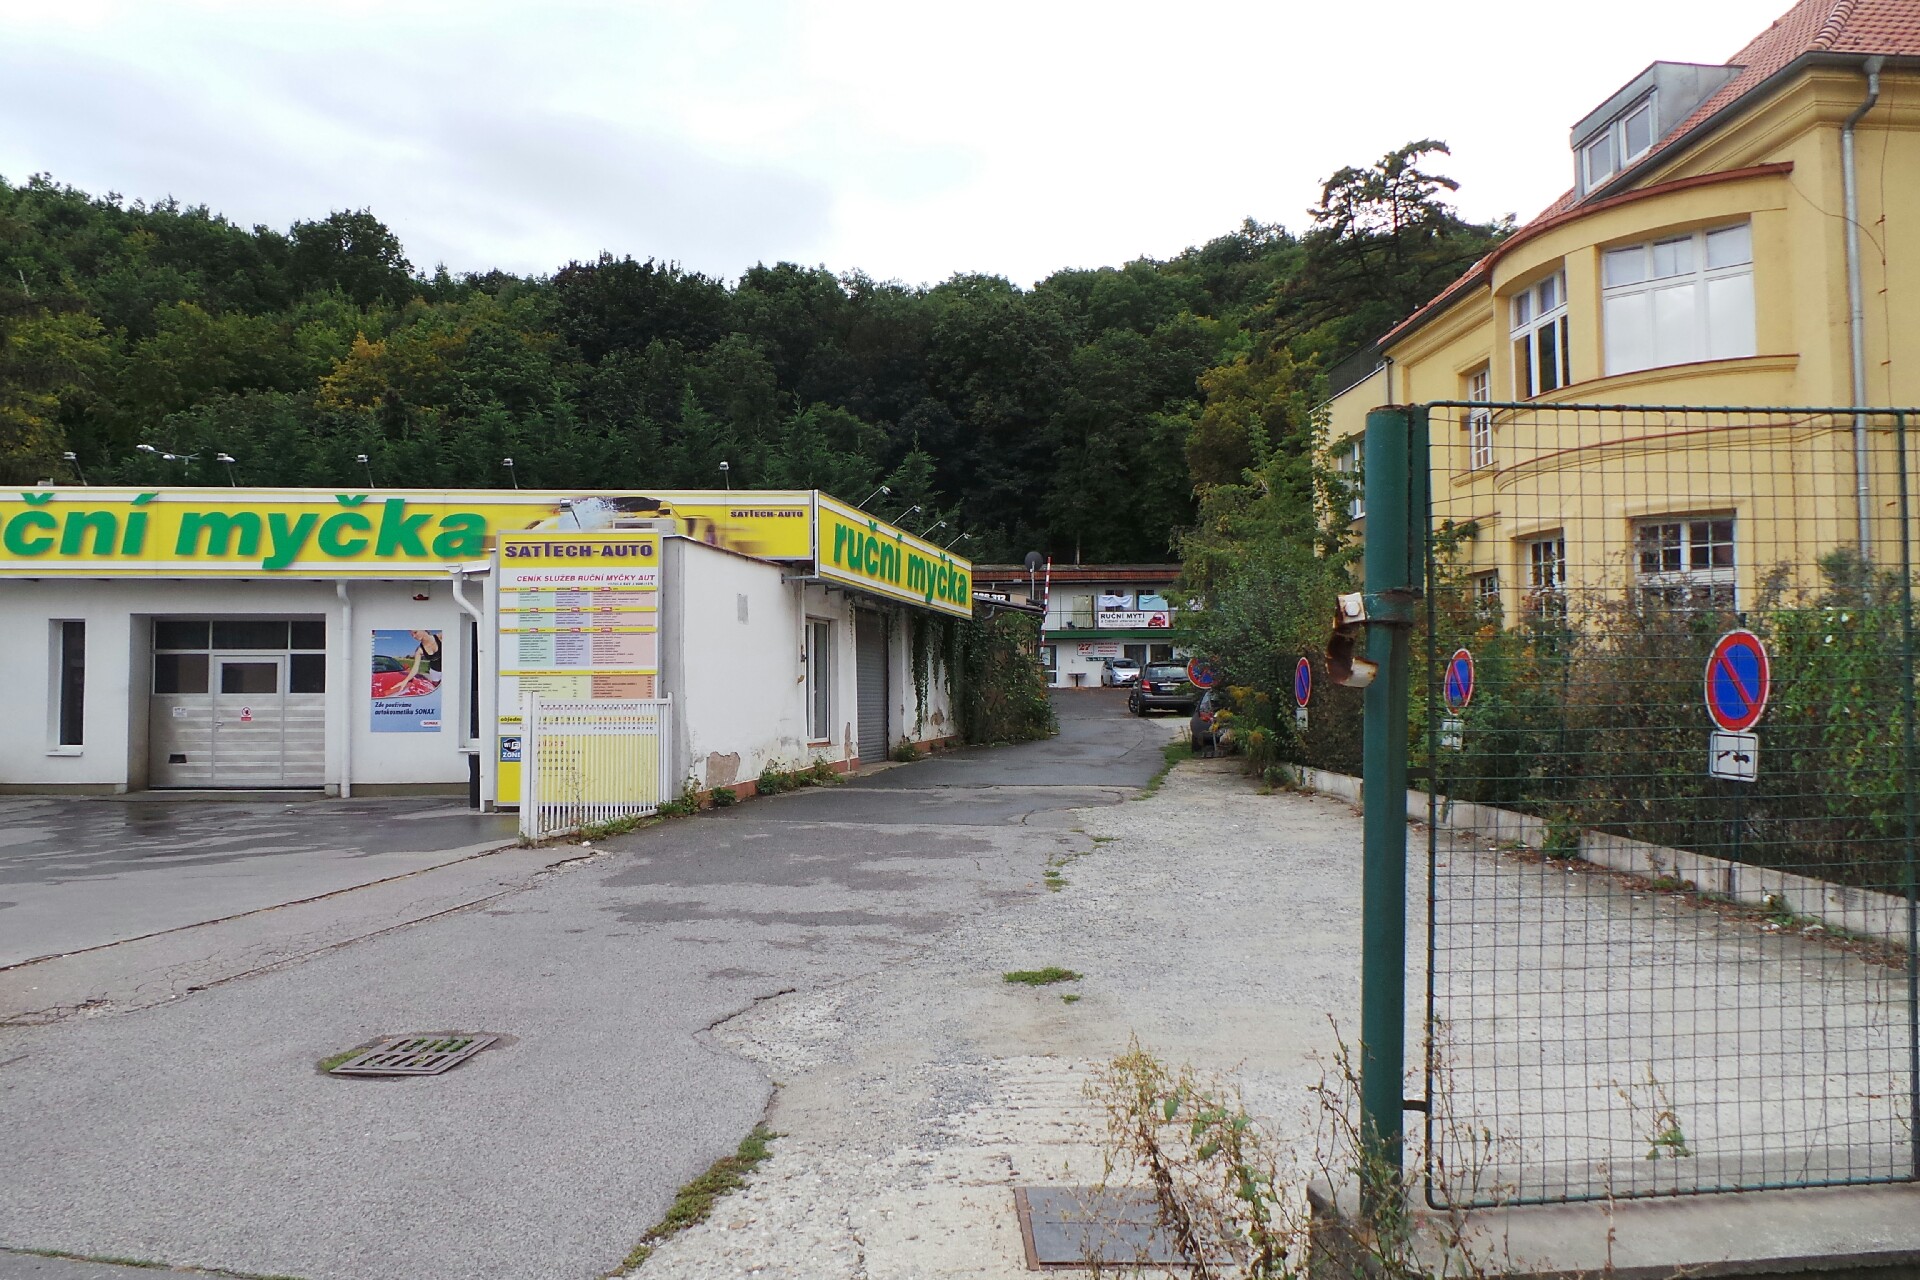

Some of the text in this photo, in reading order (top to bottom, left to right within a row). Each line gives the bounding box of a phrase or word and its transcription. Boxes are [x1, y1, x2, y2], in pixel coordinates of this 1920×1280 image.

[730, 509, 804, 518] SATTECH-AUTO
[0, 493, 487, 570] ční myčka
[504, 540, 654, 559] SATTECH-AUTO
[833, 519, 968, 605] ruční myčka
[516, 574, 542, 582] CENÍK
[544, 574, 576, 582] SLUŽEB
[577, 573, 605, 582] RUČNÍ
[606, 573, 637, 582] MYČKY
